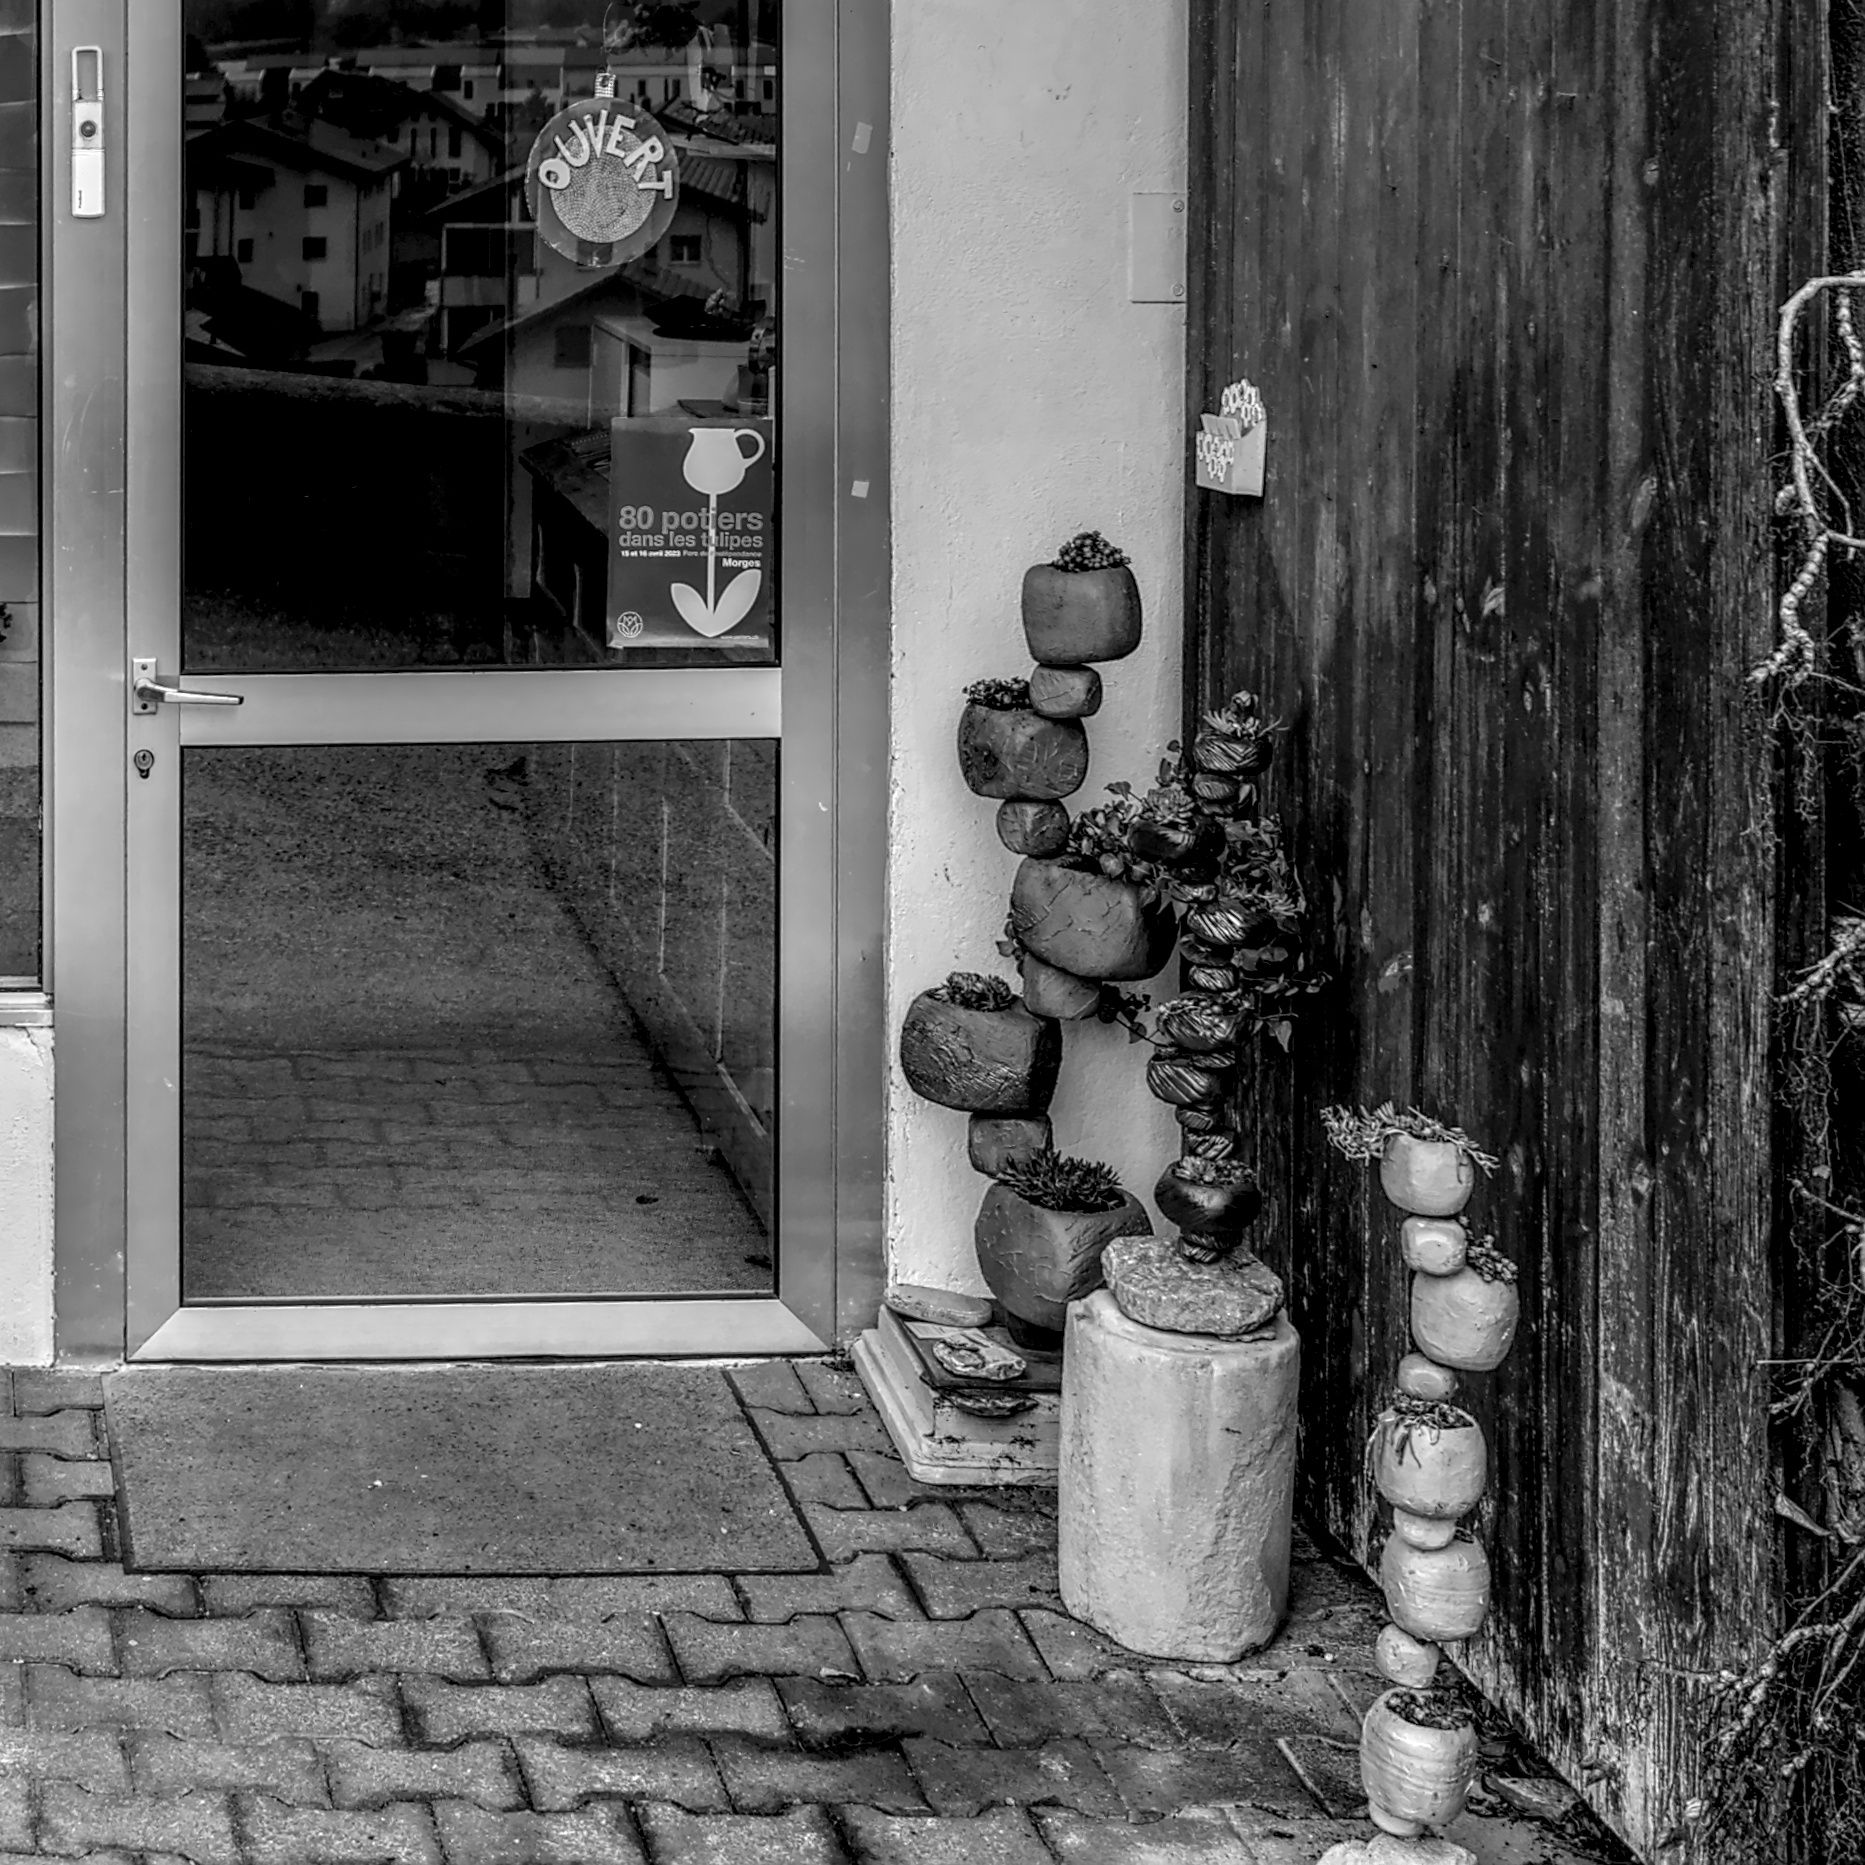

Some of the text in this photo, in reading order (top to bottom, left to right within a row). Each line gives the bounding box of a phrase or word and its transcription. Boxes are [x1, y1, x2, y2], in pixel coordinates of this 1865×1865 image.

[538, 108, 674, 201] OUVERT
[618, 505, 764, 535] 80 potiers
[618, 531, 764, 551] dans les tulipes
[722, 557, 762, 569] Morges
